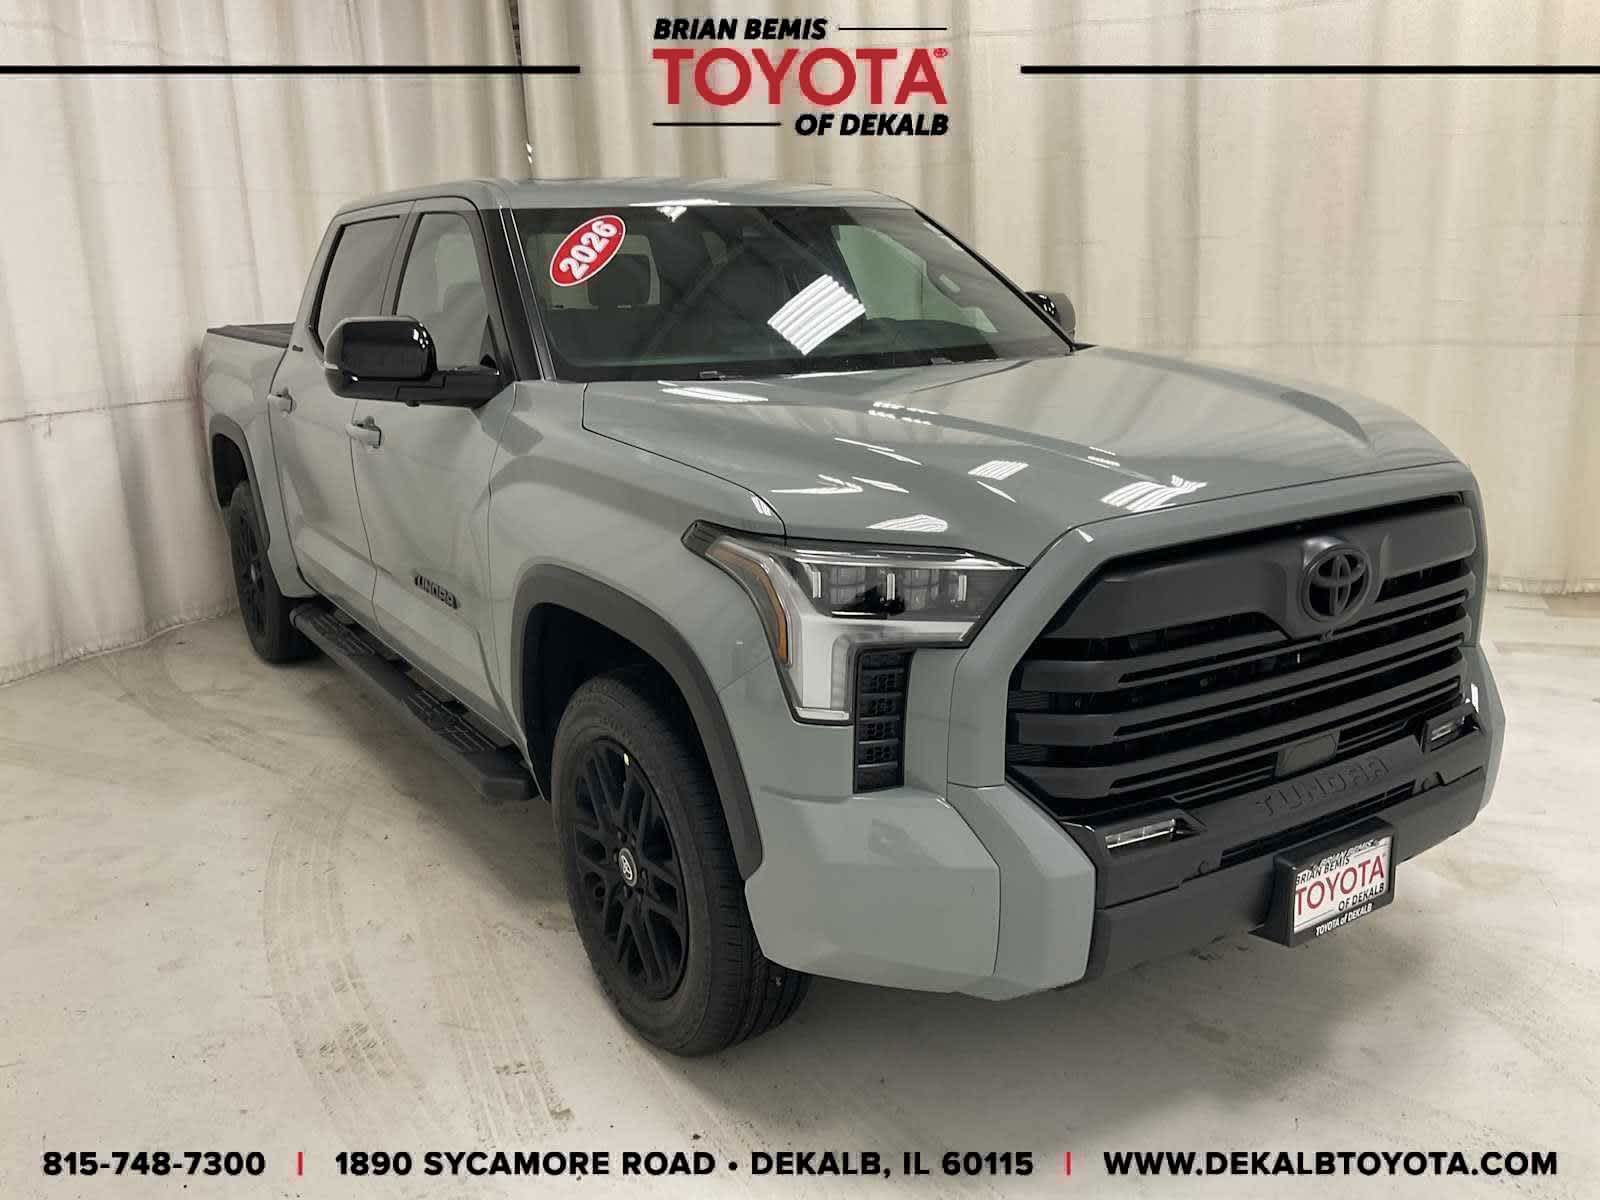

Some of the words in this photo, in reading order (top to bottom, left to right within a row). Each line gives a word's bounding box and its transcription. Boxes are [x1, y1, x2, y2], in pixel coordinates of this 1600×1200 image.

[559, 220, 618, 281] 2026
[1256, 756, 1390, 816] TUNDRA
[1296, 855, 1385, 916] TOYOTA
[1338, 898, 1350, 911] OF
[1351, 882, 1385, 906] DEKALB
[1315, 918, 1340, 936] TOYOTA
[1348, 902, 1373, 921] DEKALB
